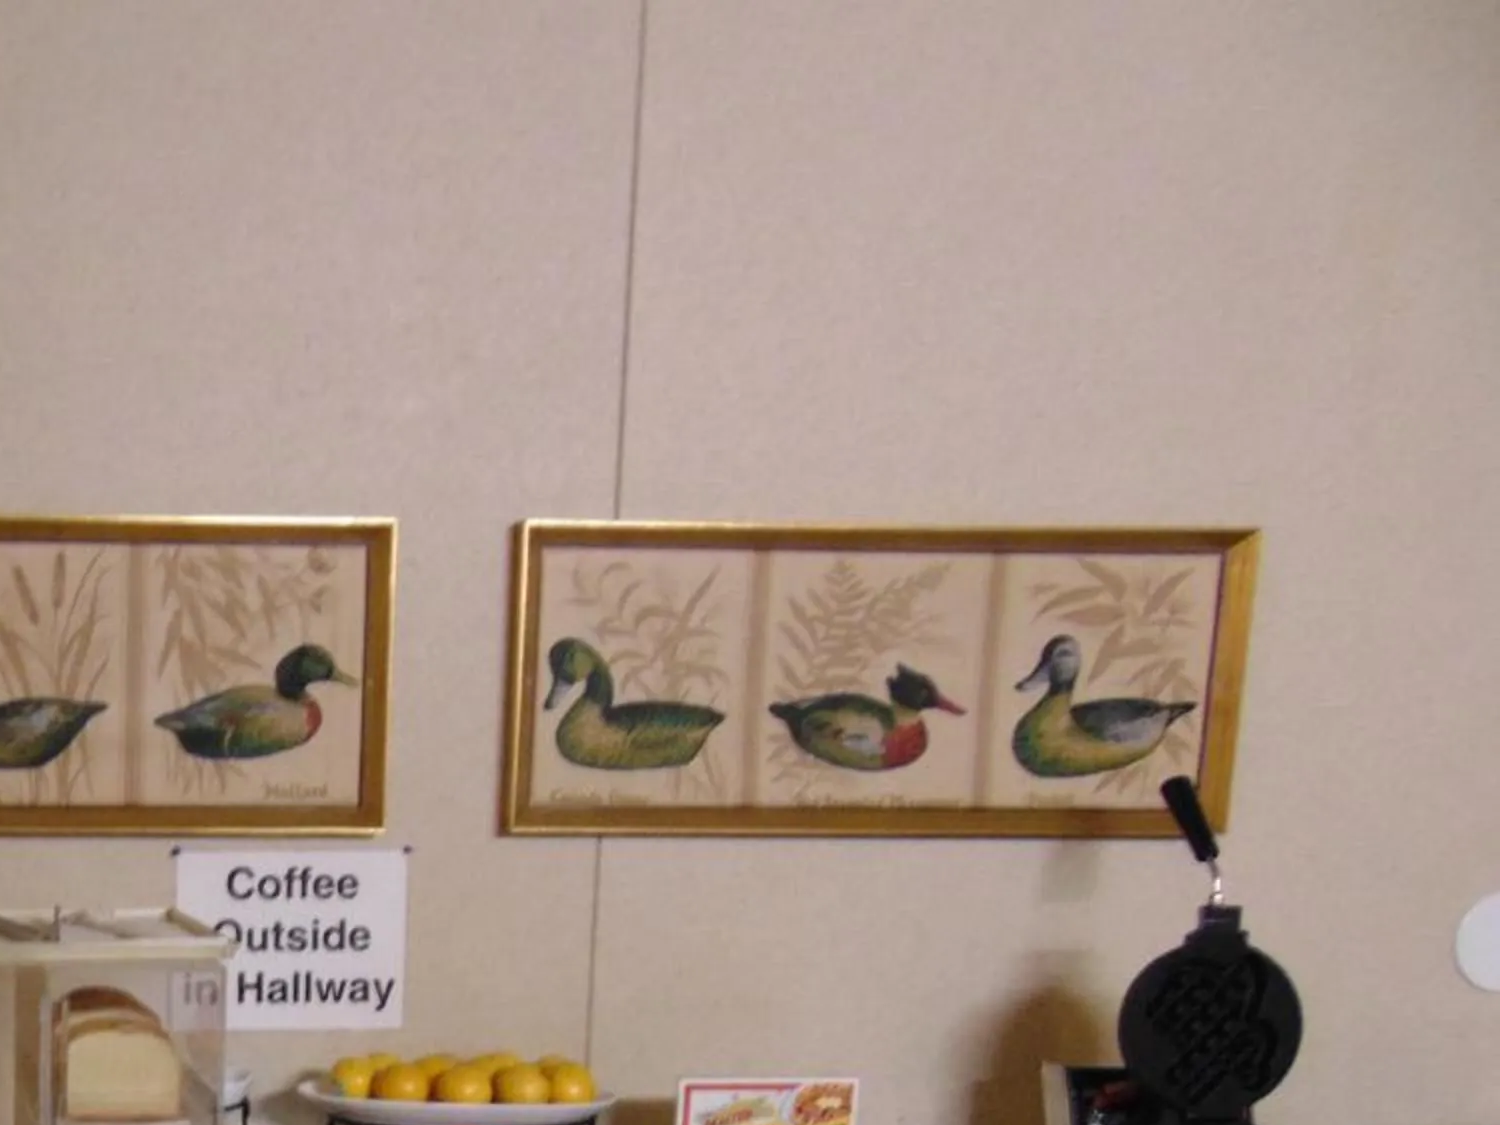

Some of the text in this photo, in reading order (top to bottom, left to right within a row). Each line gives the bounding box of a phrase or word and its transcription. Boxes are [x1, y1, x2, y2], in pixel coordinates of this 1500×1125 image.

[226, 866, 359, 900] Coffee
[214, 919, 371, 951] Outside
[184, 971, 396, 1011] in Hallway
